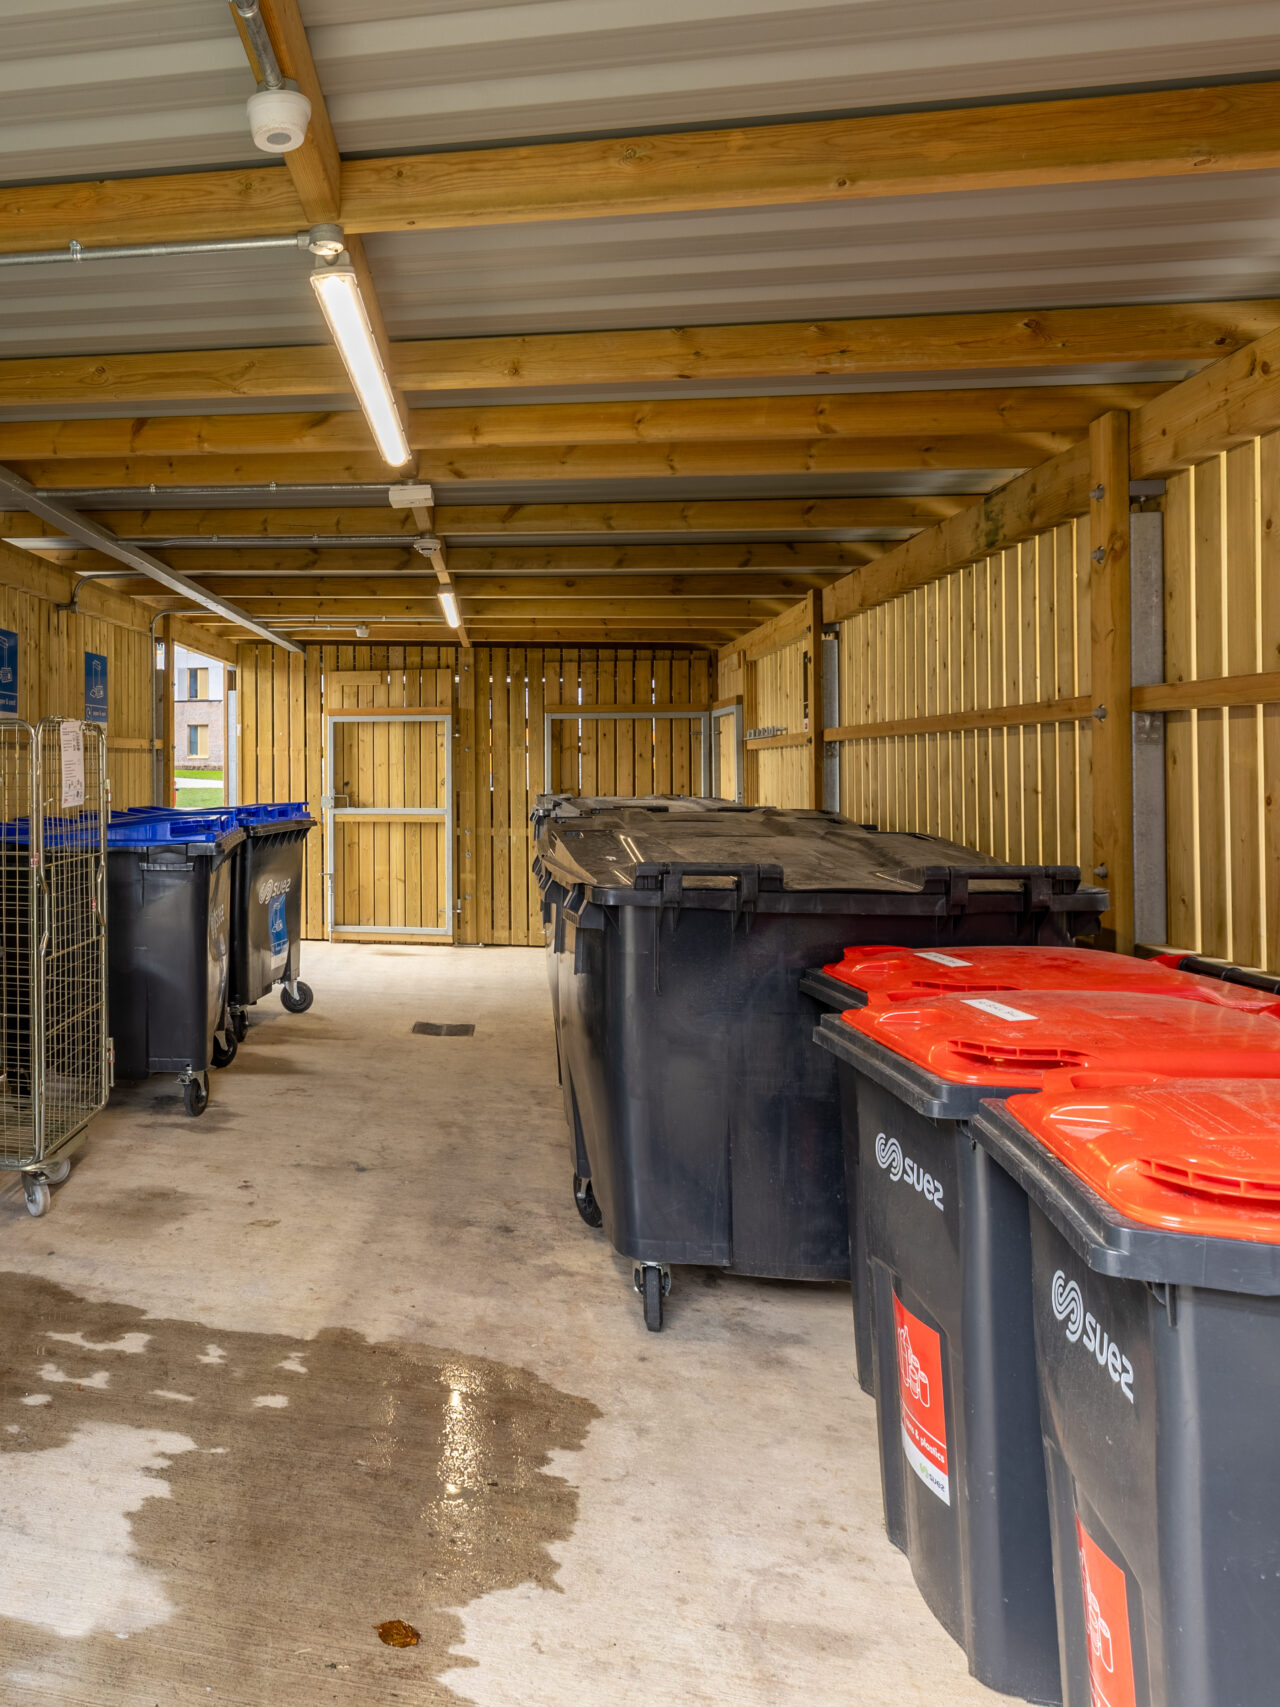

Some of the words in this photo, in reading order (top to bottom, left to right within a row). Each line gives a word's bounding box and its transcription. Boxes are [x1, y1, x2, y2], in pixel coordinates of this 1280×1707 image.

[273, 878, 291, 897] suez
[903, 1156, 944, 1212] suez
[1082, 1311, 1134, 1405] suez
[920, 1437, 946, 1464] plastics
[928, 1473, 945, 1493] suez
